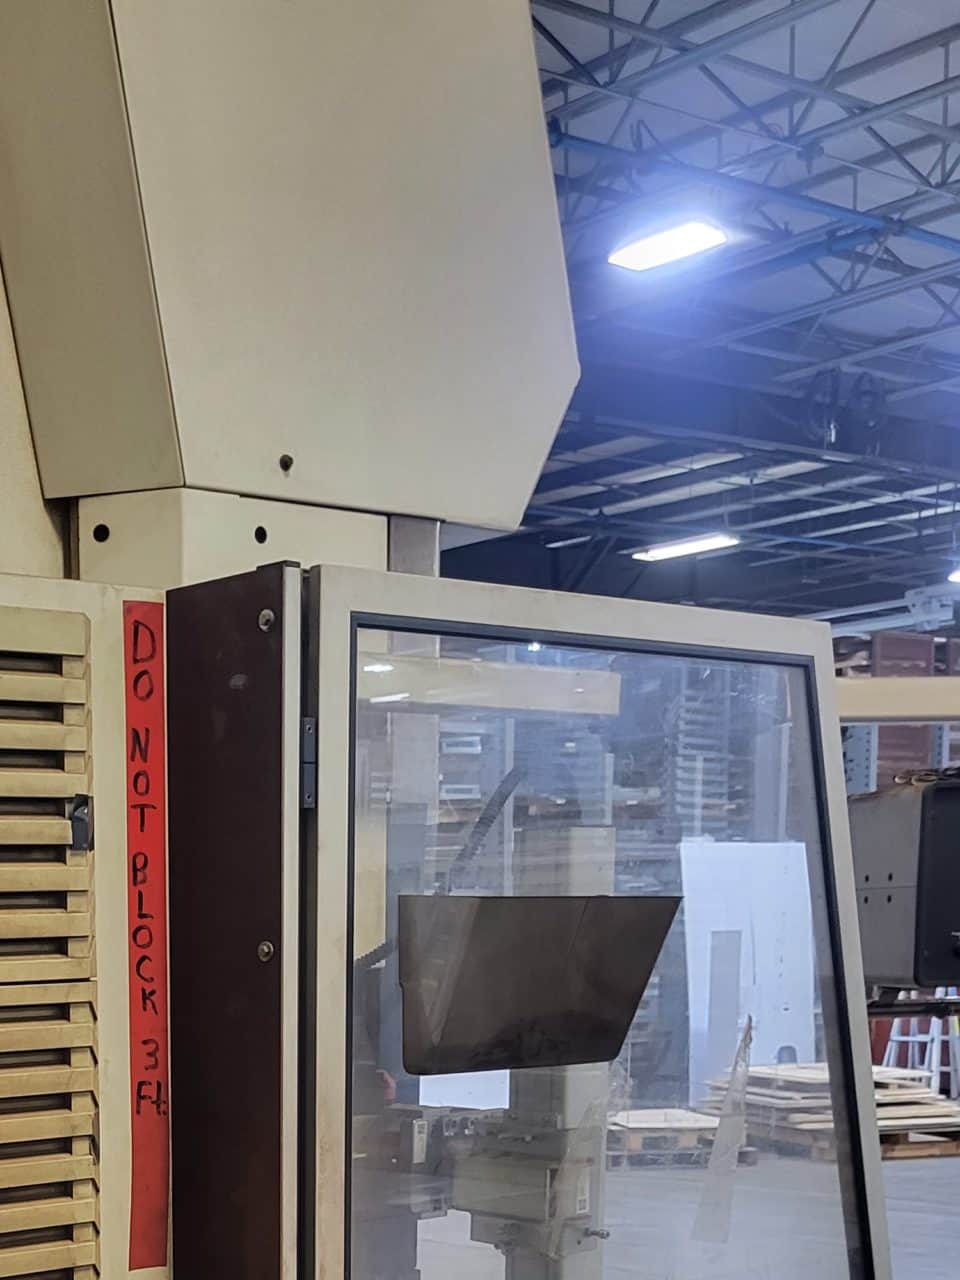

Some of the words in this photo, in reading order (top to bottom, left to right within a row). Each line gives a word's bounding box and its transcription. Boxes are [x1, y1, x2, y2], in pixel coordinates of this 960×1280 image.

[132, 619, 157, 702] DO
[130, 727, 158, 833] NOT
[132, 851, 159, 1016] BLOCK
[141, 1038, 160, 1071] 3
